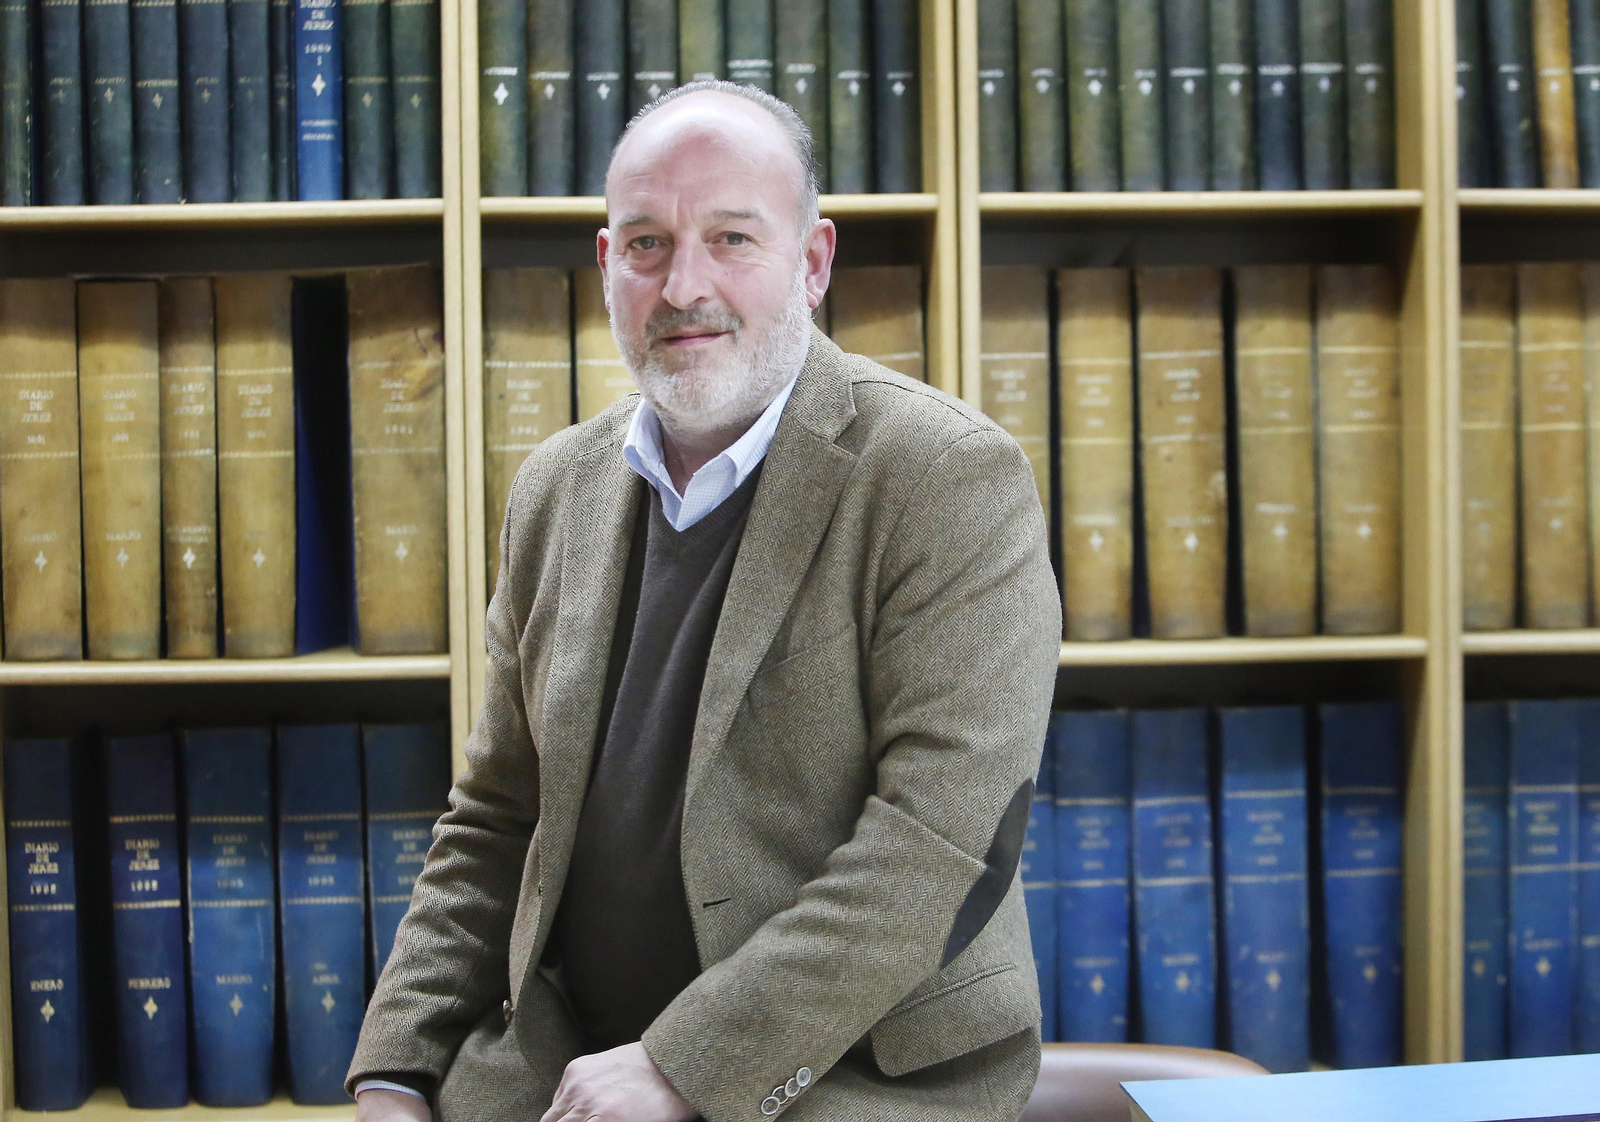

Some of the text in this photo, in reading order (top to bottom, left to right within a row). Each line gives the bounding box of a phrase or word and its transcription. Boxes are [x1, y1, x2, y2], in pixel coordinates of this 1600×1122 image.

[19, 389, 54, 401] DIARIO
[29, 402, 43, 411] DE
[21, 412, 52, 423] JEREZ
[24, 841, 60, 854] DIARIO
[124, 838, 160, 851] DIARIO
[35, 853, 50, 864] DE
[136, 850, 151, 860] DE
[28, 862, 59, 875] JEREZ
[128, 859, 160, 872] JEREZ
[30, 978, 64, 992] ENERO
[127, 976, 171, 990] FEBRERO
